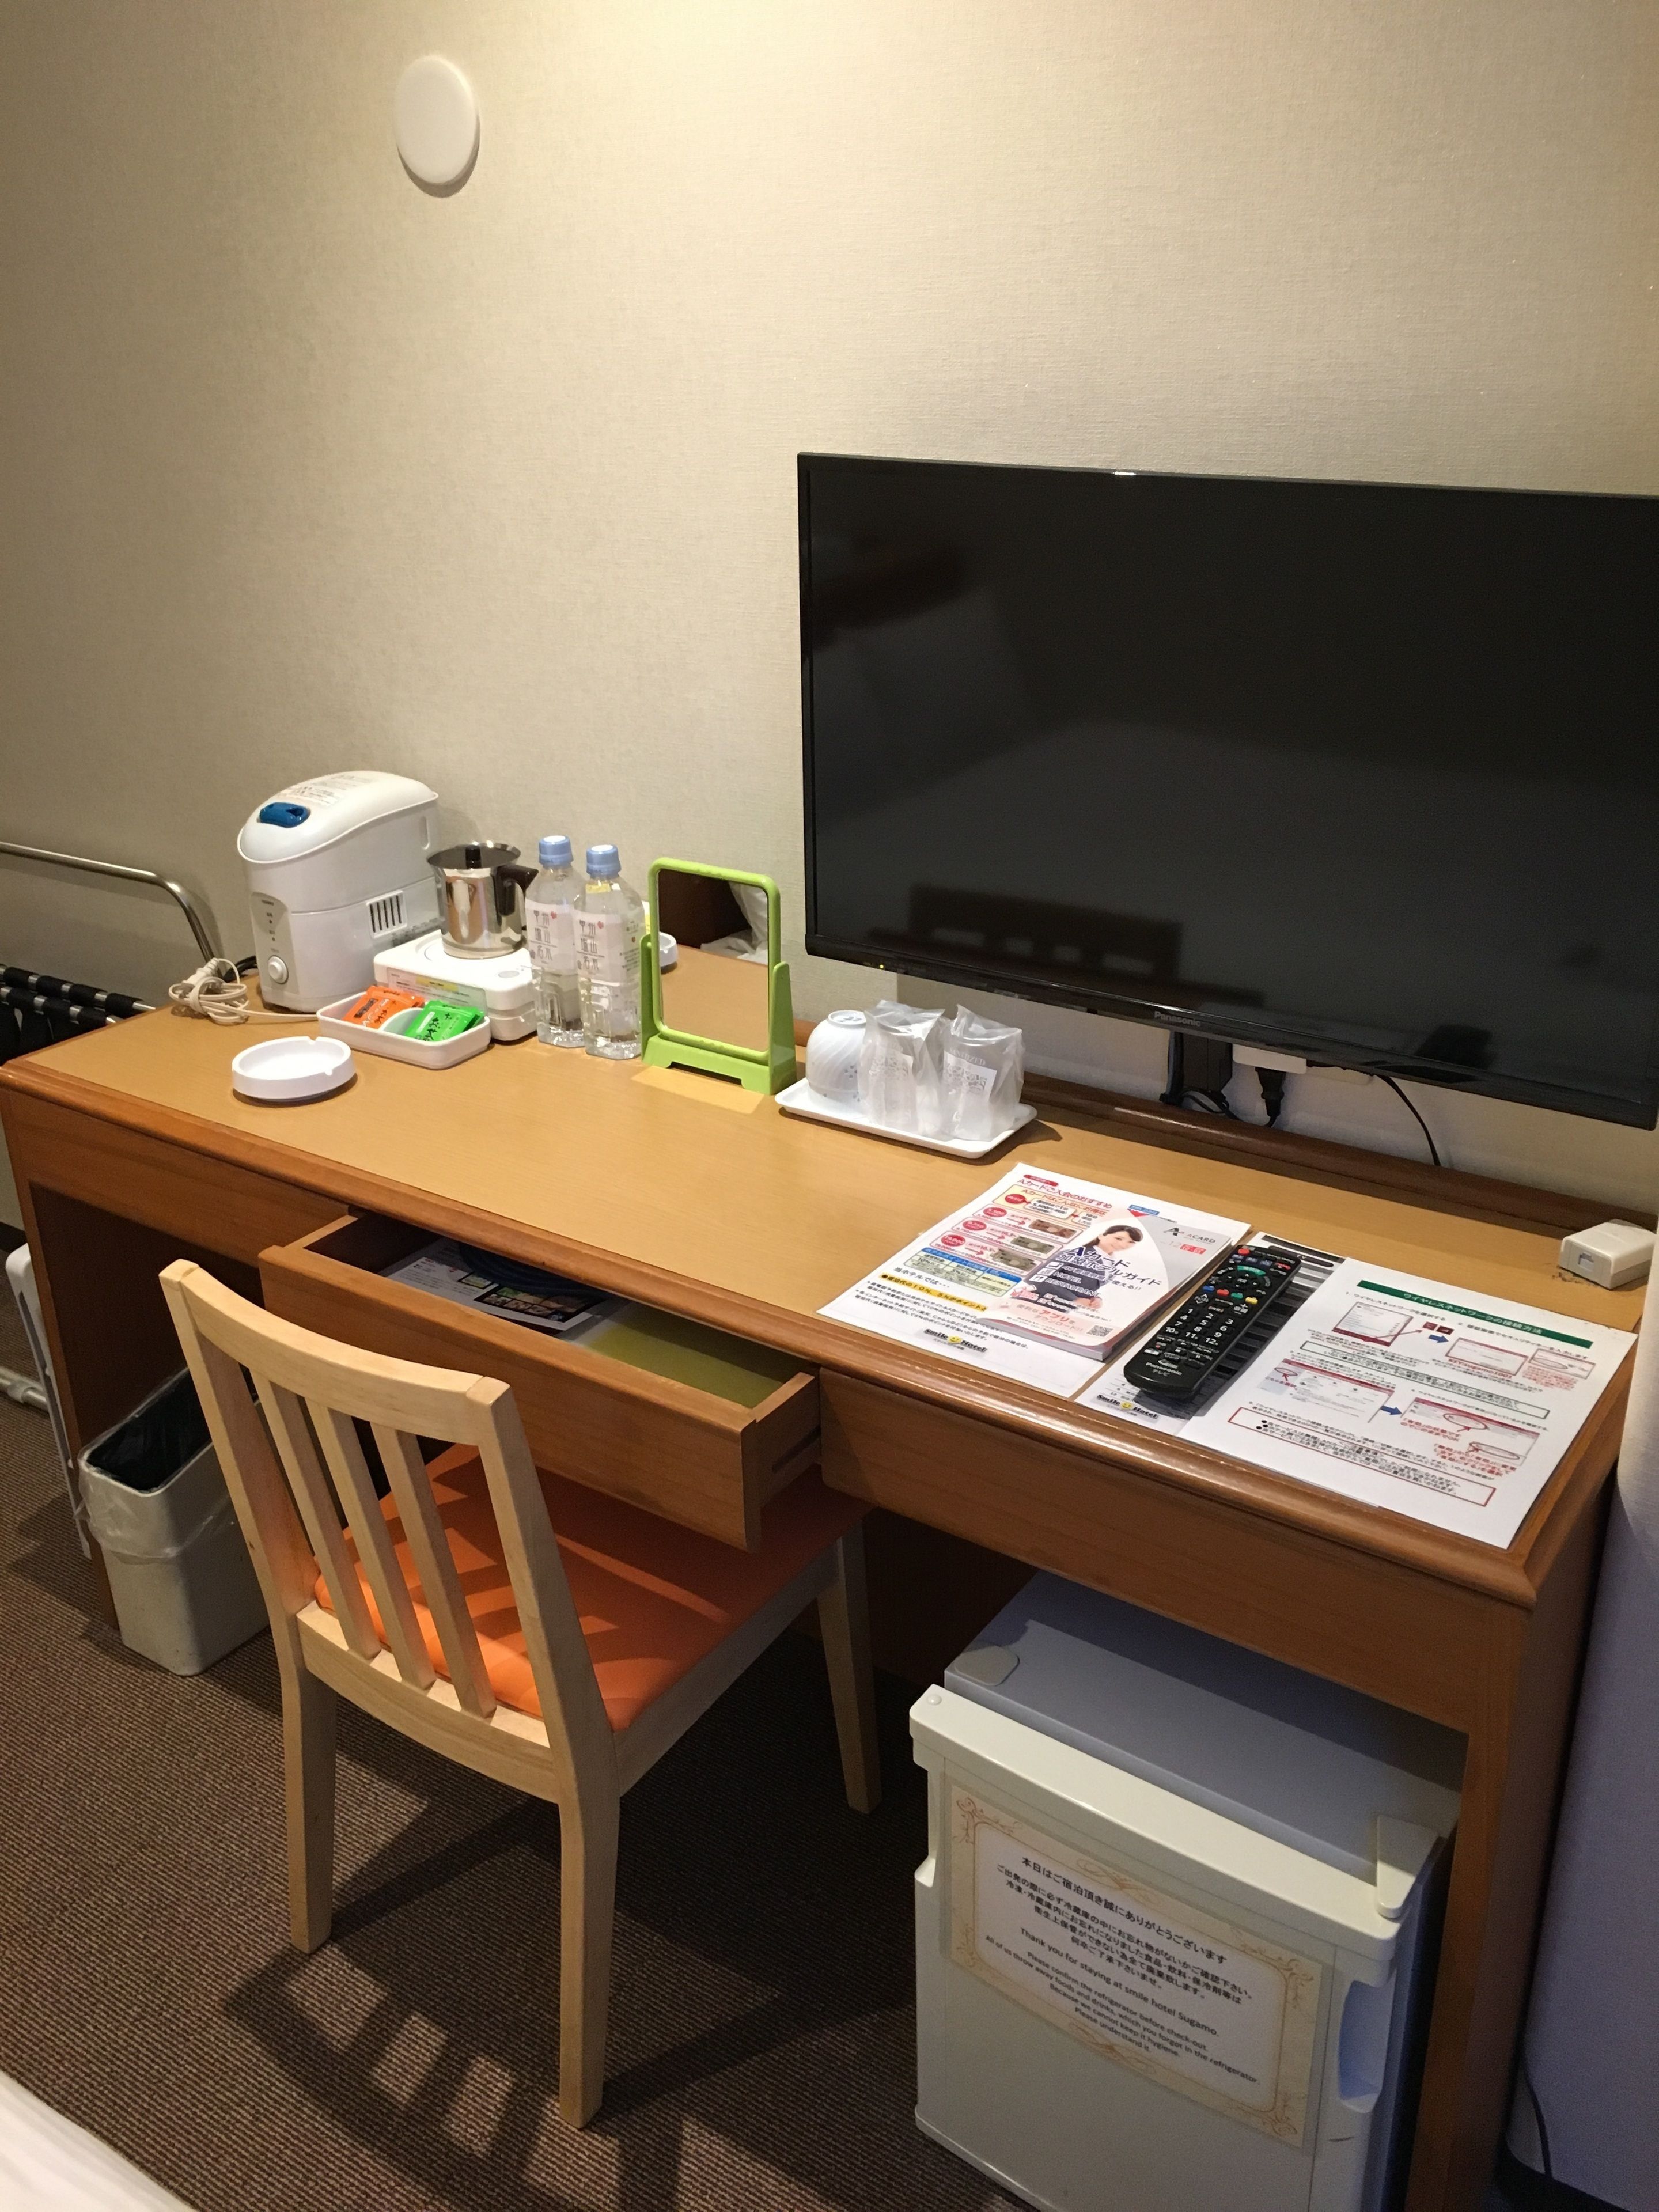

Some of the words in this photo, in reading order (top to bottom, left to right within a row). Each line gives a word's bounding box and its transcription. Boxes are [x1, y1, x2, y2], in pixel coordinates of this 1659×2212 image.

[1154, 1011, 1202, 1027] Panasonic
[1186, 1233, 1216, 1244] ACARD
[1056, 1253, 1162, 1286] 加盟ホテルガイド
[1068, 1247, 1131, 1268] Aカード
[1045, 1278, 1101, 1297] RESTAURANT
[1053, 1271, 1082, 1284] HOTEL
[1400, 1293, 1544, 1335] ワイヤレスネットワークの接続方法
[924, 1328, 949, 1339] Smile
[960, 1340, 987, 1352] Hotel
[1146, 1362, 1182, 1376] Panasonic
[1097, 1395, 1121, 1406] Smile
[1133, 1406, 1159, 1419] Hotel
[1021, 1857, 1227, 1964] 本日はご宿泊頂き誠にありがとうございます
[1070, 1936, 1161, 1988] 何卒ご了承下さいませ。
[1020, 1927, 1045, 1946] Thank
[1047, 1944, 1063, 1957] you
[1065, 1952, 1078, 1964] for
[1080, 1962, 1111, 1985] staying
[1112, 1980, 1122, 1990] at
[1124, 1986, 1149, 2003] smile
[1151, 1998, 1176, 2016] hotel
[1177, 2012, 1217, 2035] Sugamo.
[1027, 1951, 1050, 1968] Please
[1051, 1966, 1078, 1985] confirm
[1080, 1982, 1093, 1993] the
[1094, 1990, 1137, 2016] refrigerator
[1139, 2013, 1165, 2031] before
[985, 1935, 994, 1944] All
[1003, 1947, 1012, 1956] us
[1012, 1952, 1033, 1968] throw
[1035, 1966, 1053, 1980] away
[1054, 1976, 1074, 1993] foods
[1076, 1990, 1090, 2001] and
[1091, 1998, 1115, 2015] drinks,
[1118, 2013, 1141, 2027] which
[1142, 2025, 1157, 2036] you
[1158, 2032, 1183, 2049] forgot
[1184, 2045, 1192, 2053] in
[1194, 2050, 1208, 2061] the
[1049, 1982, 1079, 2003] Because
[1092, 2008, 1118, 2026] cannot
[1119, 2022, 1139, 2036] keep
[1074, 2006, 1098, 2024] Please
[1099, 2021, 1142, 2048] understand
